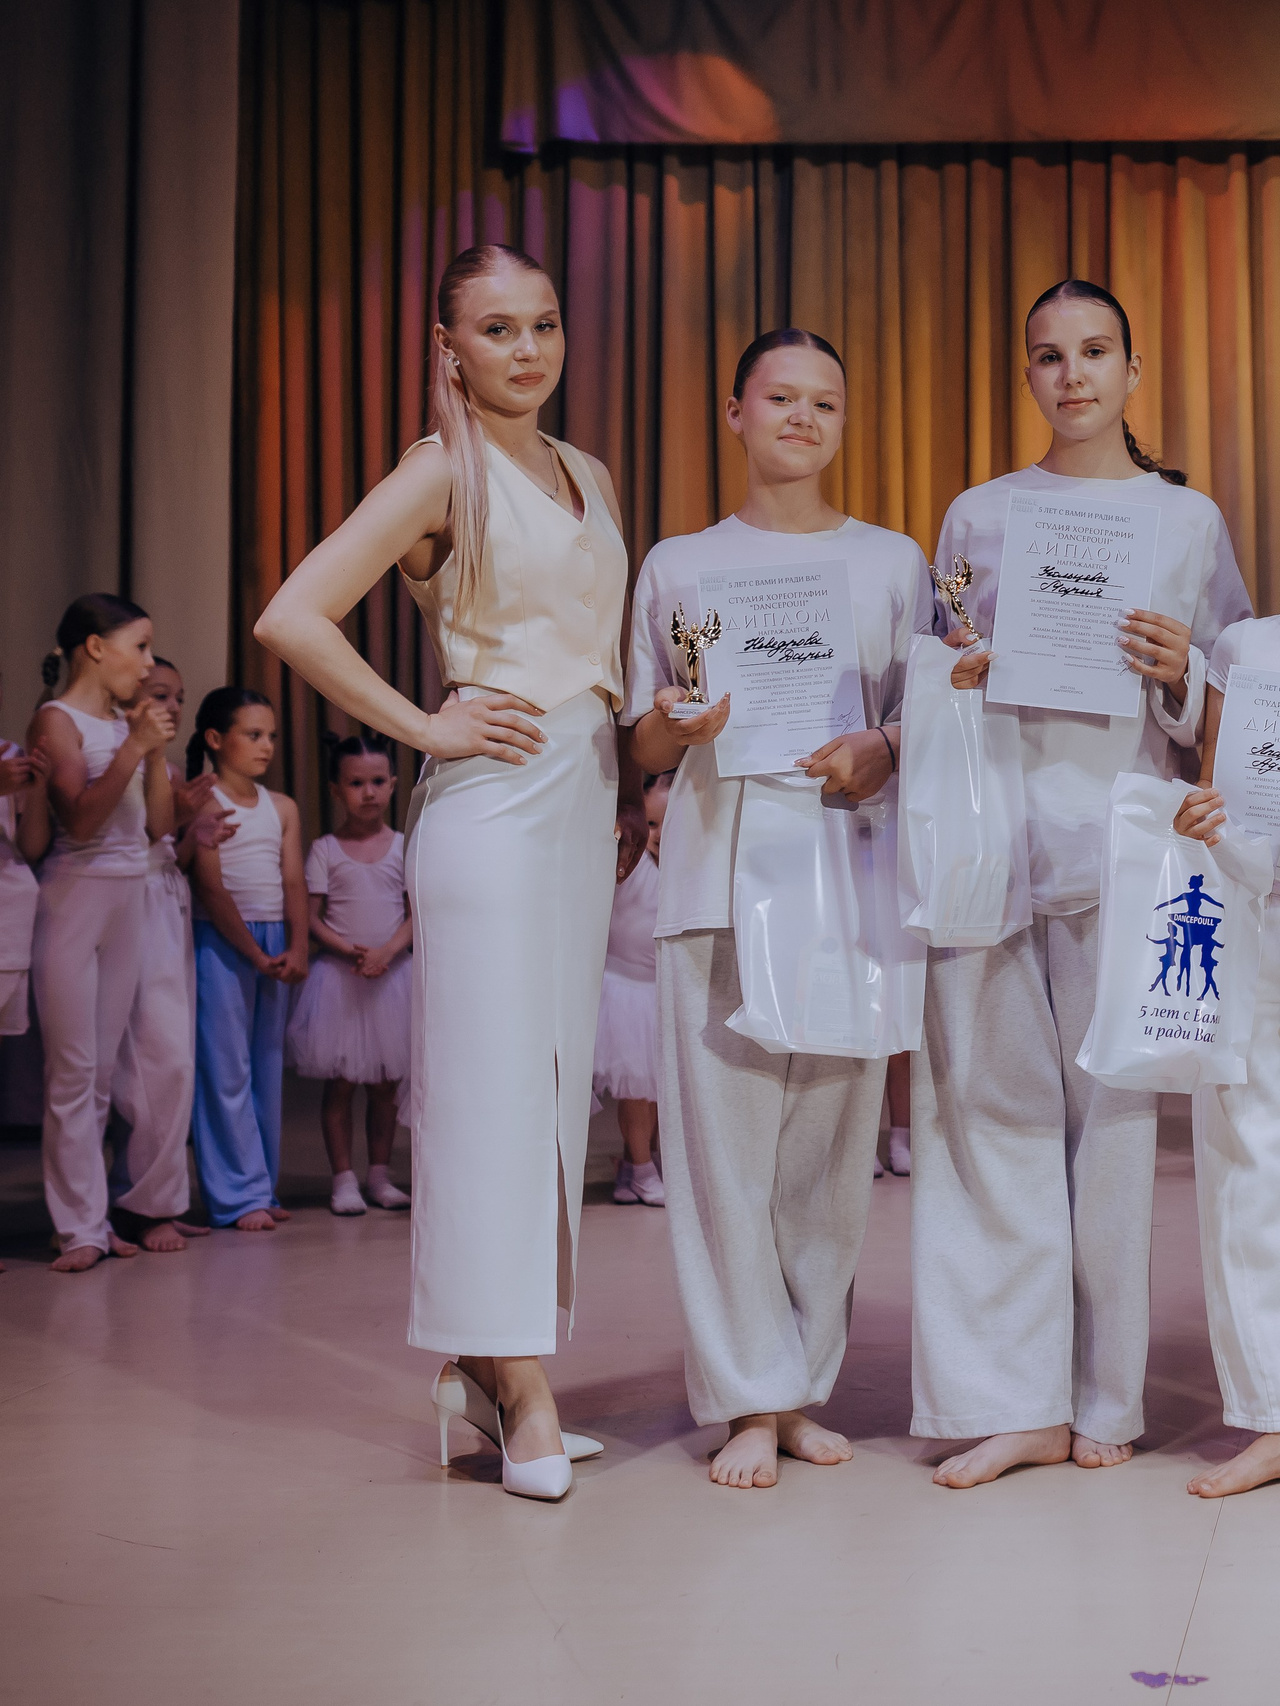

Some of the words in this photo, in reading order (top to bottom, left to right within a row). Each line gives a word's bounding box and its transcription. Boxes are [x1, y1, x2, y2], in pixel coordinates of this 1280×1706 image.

[1064, 509, 1086, 517] ВАМИ
[1034, 521, 1069, 531] СТУДИЯ
[1072, 526, 1134, 539] ХОРЕОГРАФИИ
[1025, 539, 1132, 565] ДИПЛОМ
[1056, 559, 1107, 570] НАГРАЖДАЕТСЯ
[1040, 578, 1103, 597] Мария
[728, 595, 763, 604] СТУДИЯ
[766, 589, 828, 600] ХОРЕОГРАФИИ
[724, 607, 830, 630] ДИПЛОМ
[758, 627, 809, 635] НАГРАЖДАЕТСЯ
[776, 648, 833, 665] Дарья
[1174, 914, 1214, 926] DANCEPOULL
[1138, 1006, 1148, 1018] 5
[1151, 1007, 1179, 1020] лет
[1184, 1011, 1190, 1020] с
[1144, 1026, 1153, 1036] и
[1156, 1024, 1190, 1041] ради
